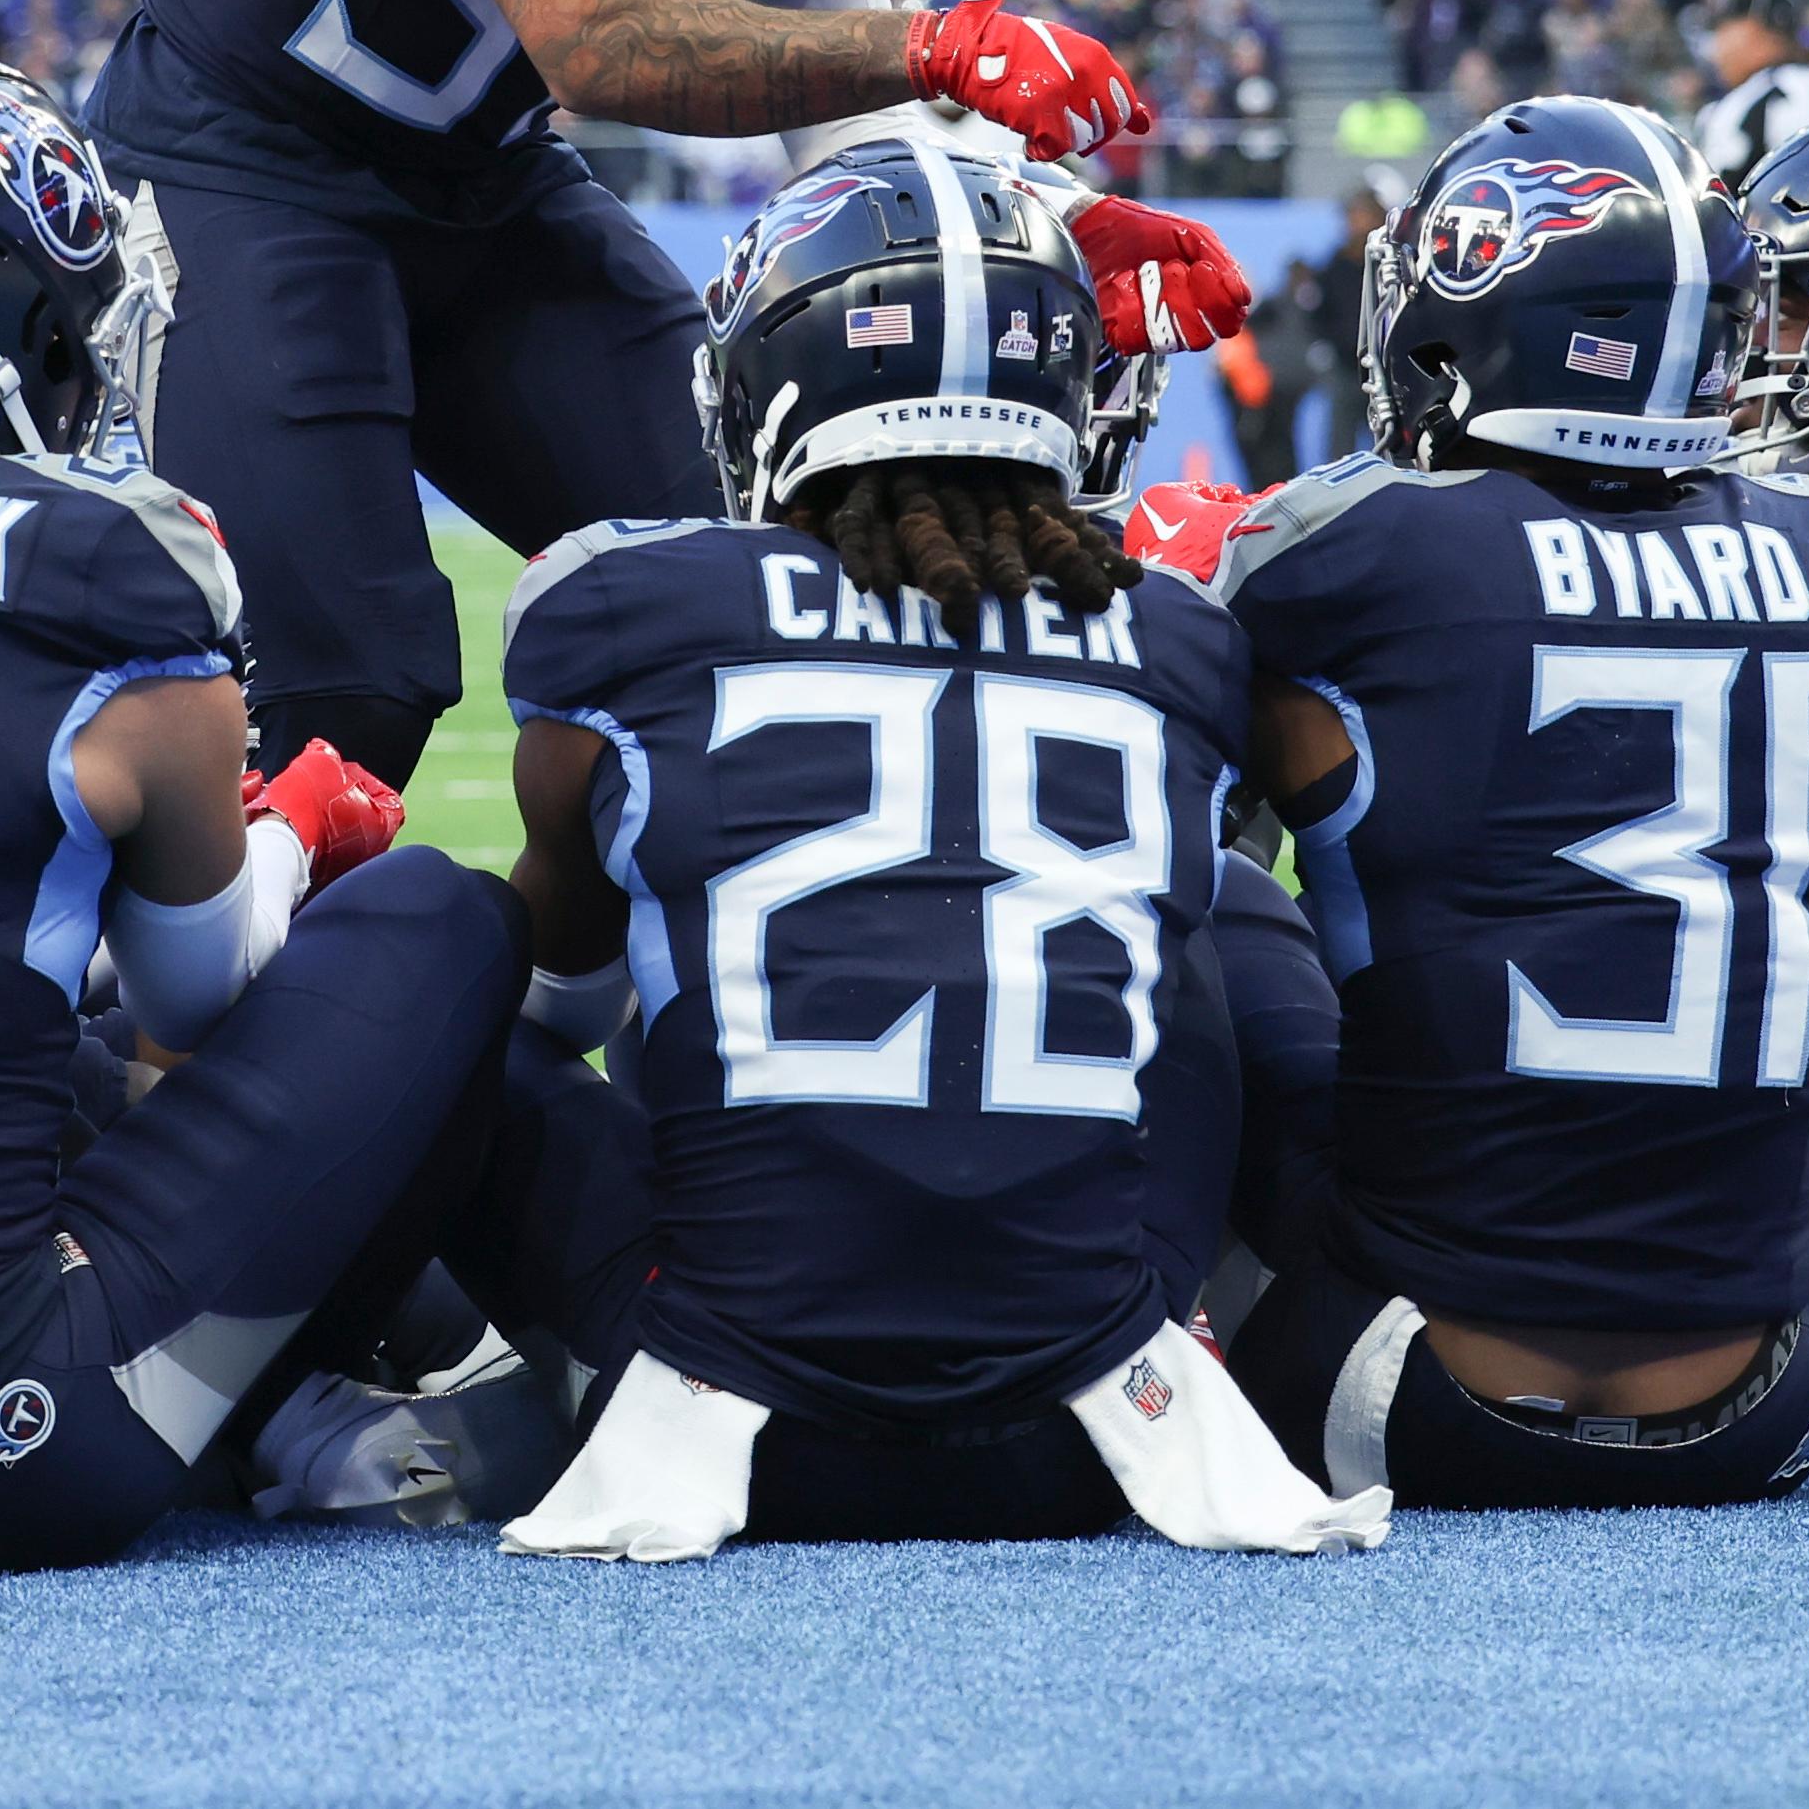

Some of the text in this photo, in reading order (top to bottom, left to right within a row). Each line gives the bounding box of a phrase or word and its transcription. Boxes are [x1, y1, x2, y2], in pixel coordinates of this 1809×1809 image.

[1000, 339, 1036, 354] CATCH
[877, 404, 1042, 429] TENNESSEE
[1554, 427, 1717, 453] TENNESSEE
[705, 660, 1172, 1126] 28
[1135, 1379, 1169, 1417] NFL
